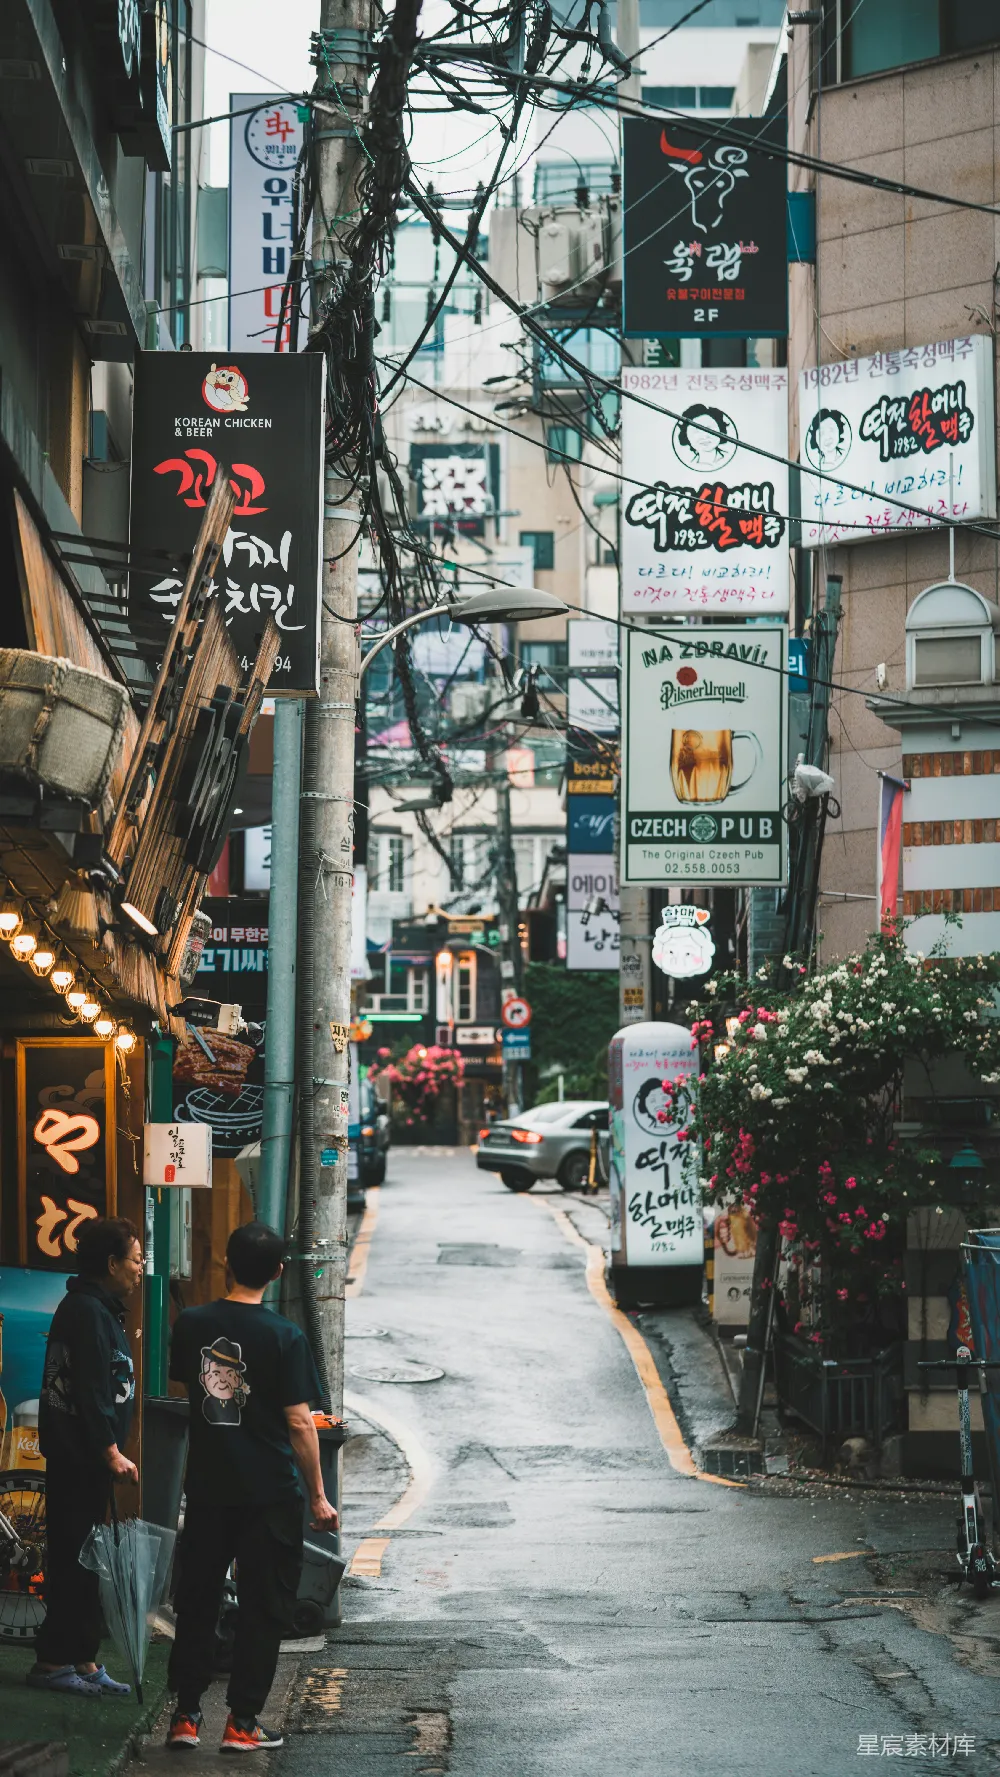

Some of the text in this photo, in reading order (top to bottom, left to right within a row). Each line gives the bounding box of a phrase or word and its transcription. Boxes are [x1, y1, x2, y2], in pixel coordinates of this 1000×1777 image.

[666, 288, 746, 301] 숯불구이전문점
[693, 308, 719, 322] 2F
[803, 337, 975, 391] 1982년 전통숙성맥주
[623, 374, 788, 391] 1982년 전통숙성맥주
[174, 418, 273, 429] KOREAN CHICKEN
[174, 428, 214, 438] & BEER
[893, 436, 917, 454] 1982
[674, 530, 708, 548] 1982
[638, 563, 772, 580] 다르다! 비교하라!
[633, 586, 775, 605] 이것이 전통생맥주다
[641, 645, 673, 668] NA
[660, 678, 746, 711] Pilsner Urquell
[630, 818, 687, 838] CZECH
[721, 818, 774, 839] PUB
[642, 850, 764, 862] The Original Czech Pub
[665, 863, 740, 874] 02.558.0053
[197, 949, 269, 972] 고기싸
[651, 1242, 681, 1253] 1982
